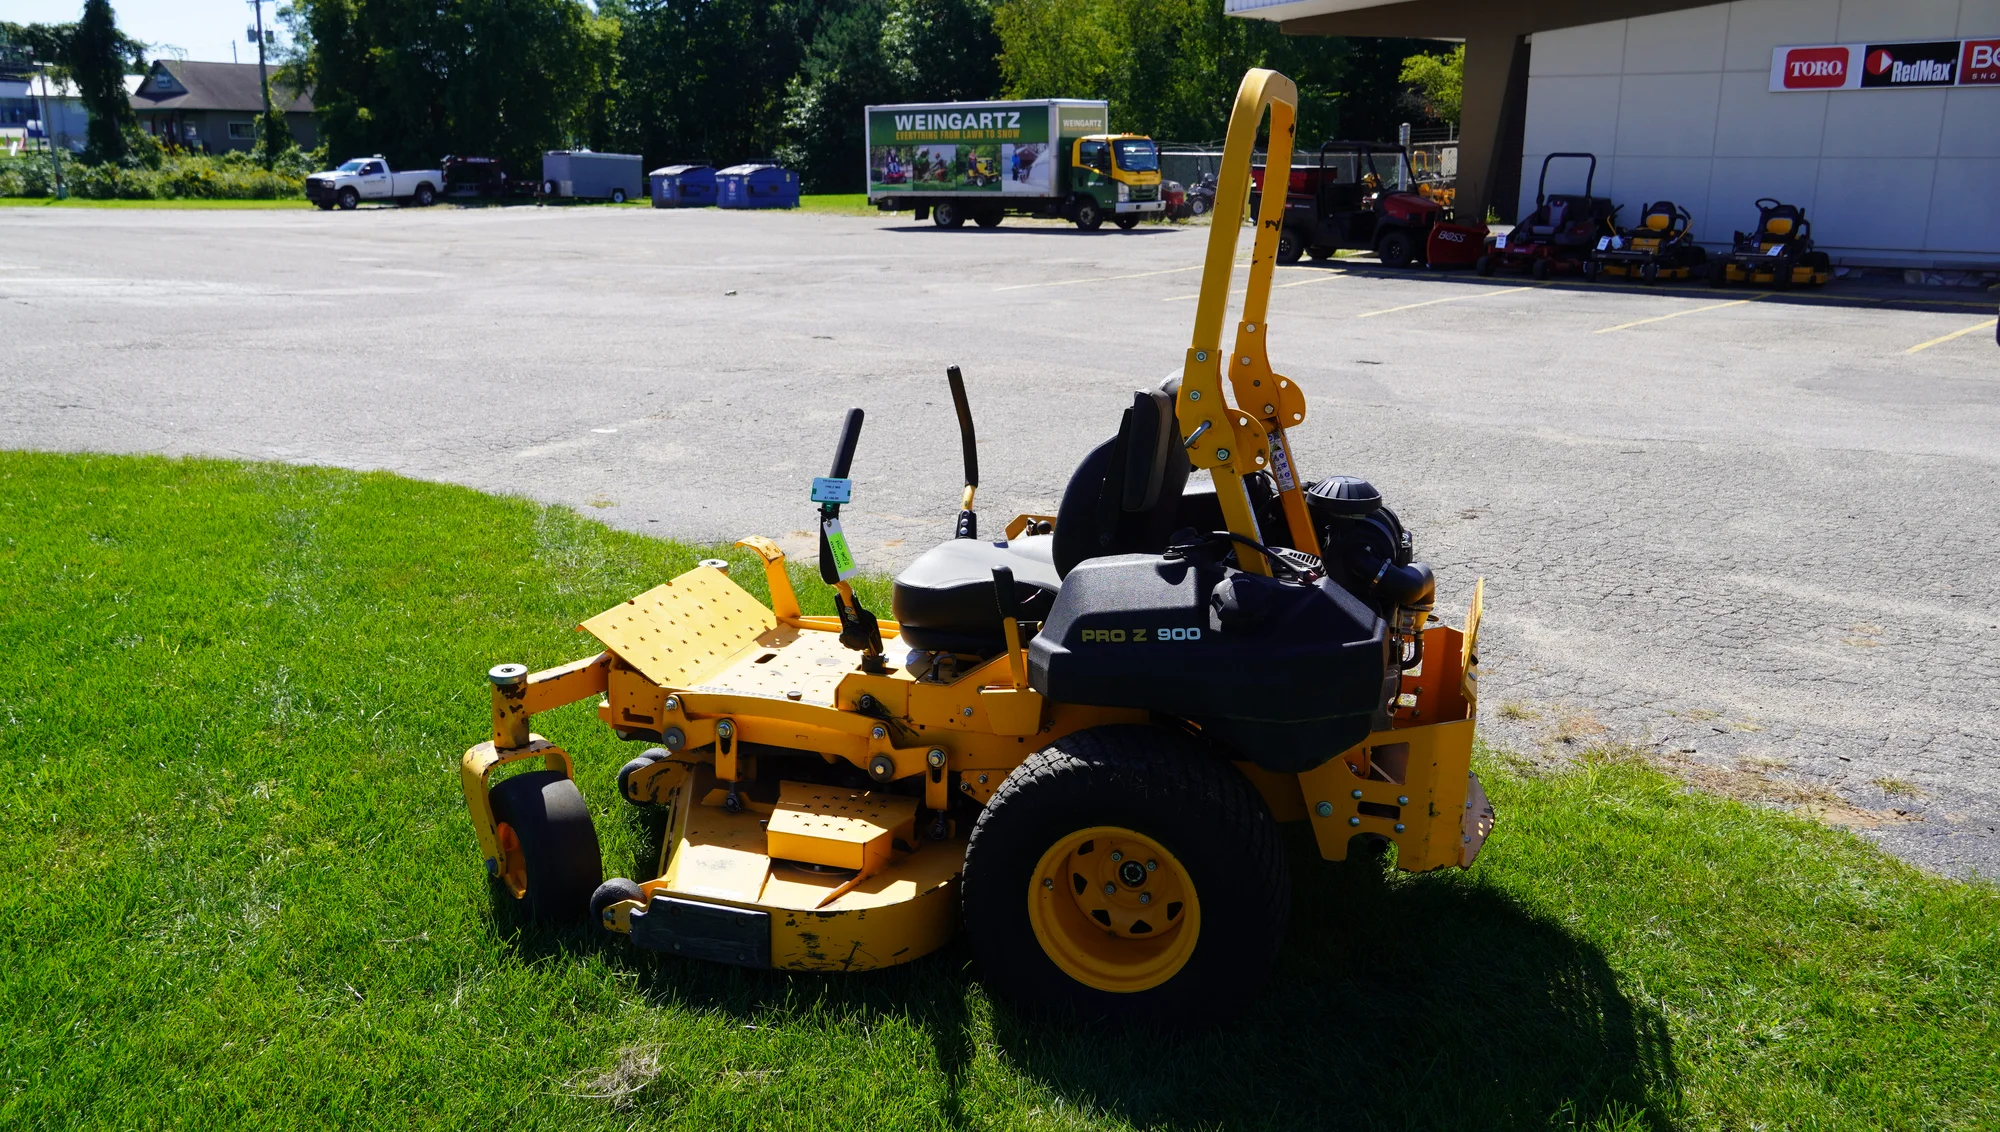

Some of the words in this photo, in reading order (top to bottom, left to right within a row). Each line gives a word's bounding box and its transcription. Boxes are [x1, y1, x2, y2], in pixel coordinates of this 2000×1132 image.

[1790, 60, 1841, 77] TORO
[894, 111, 1020, 131] WEINGARTZ
[1063, 119, 1102, 128] WEINGARTZ
[895, 130, 938, 141] EVERYTHING
[940, 130, 960, 140] FROM
[962, 129, 984, 139] LAWN
[986, 129, 995, 139] TO
[997, 128, 1020, 139] SNOW
[1438, 230, 1466, 243] BOSS
[1081, 629, 1126, 643] PRO
[1132, 629, 1147, 642] Z
[1157, 627, 1201, 641] 900
